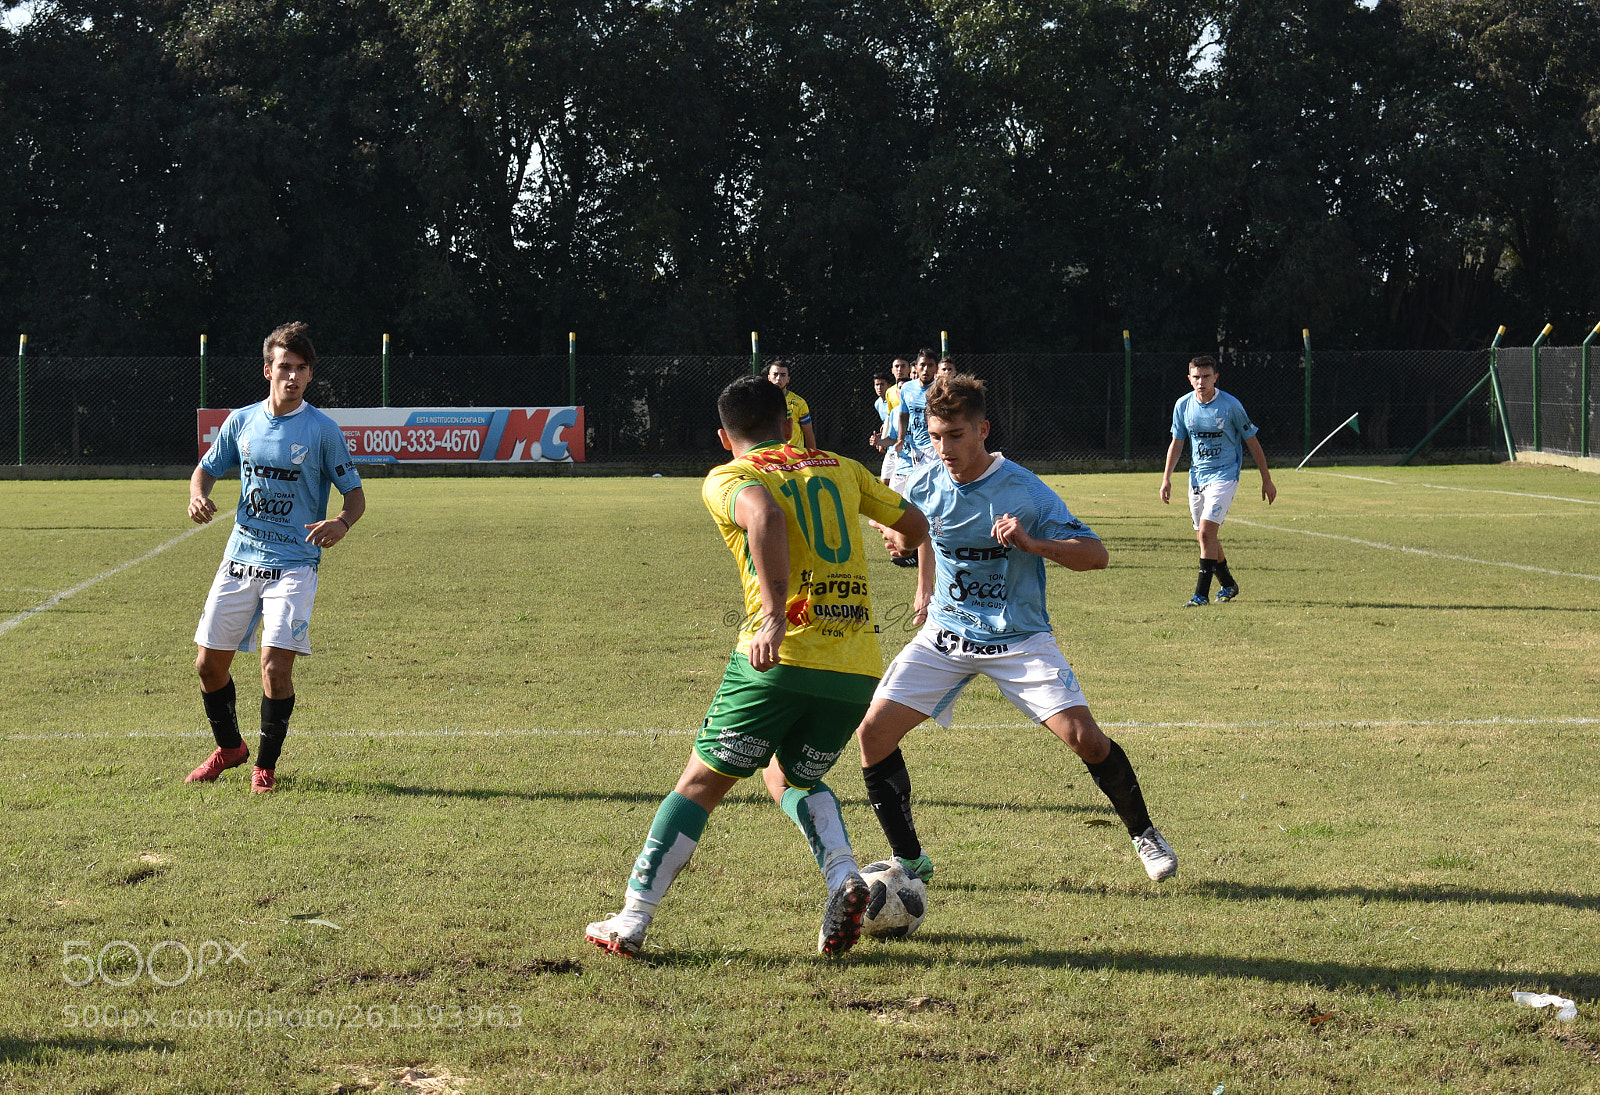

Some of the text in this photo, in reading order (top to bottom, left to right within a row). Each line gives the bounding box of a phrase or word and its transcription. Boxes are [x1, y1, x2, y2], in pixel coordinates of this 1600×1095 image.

[363, 429, 480, 453] 0800-333-4670
[254, 465, 302, 481] CETEC
[245, 487, 293, 518] Secco
[780, 475, 851, 564] 10
[821, 628, 845, 638] LYON
[962, 640, 1009, 655] Uxell
[741, 734, 771, 748] SOCIAL
[720, 747, 753, 763] QUIMICOS
